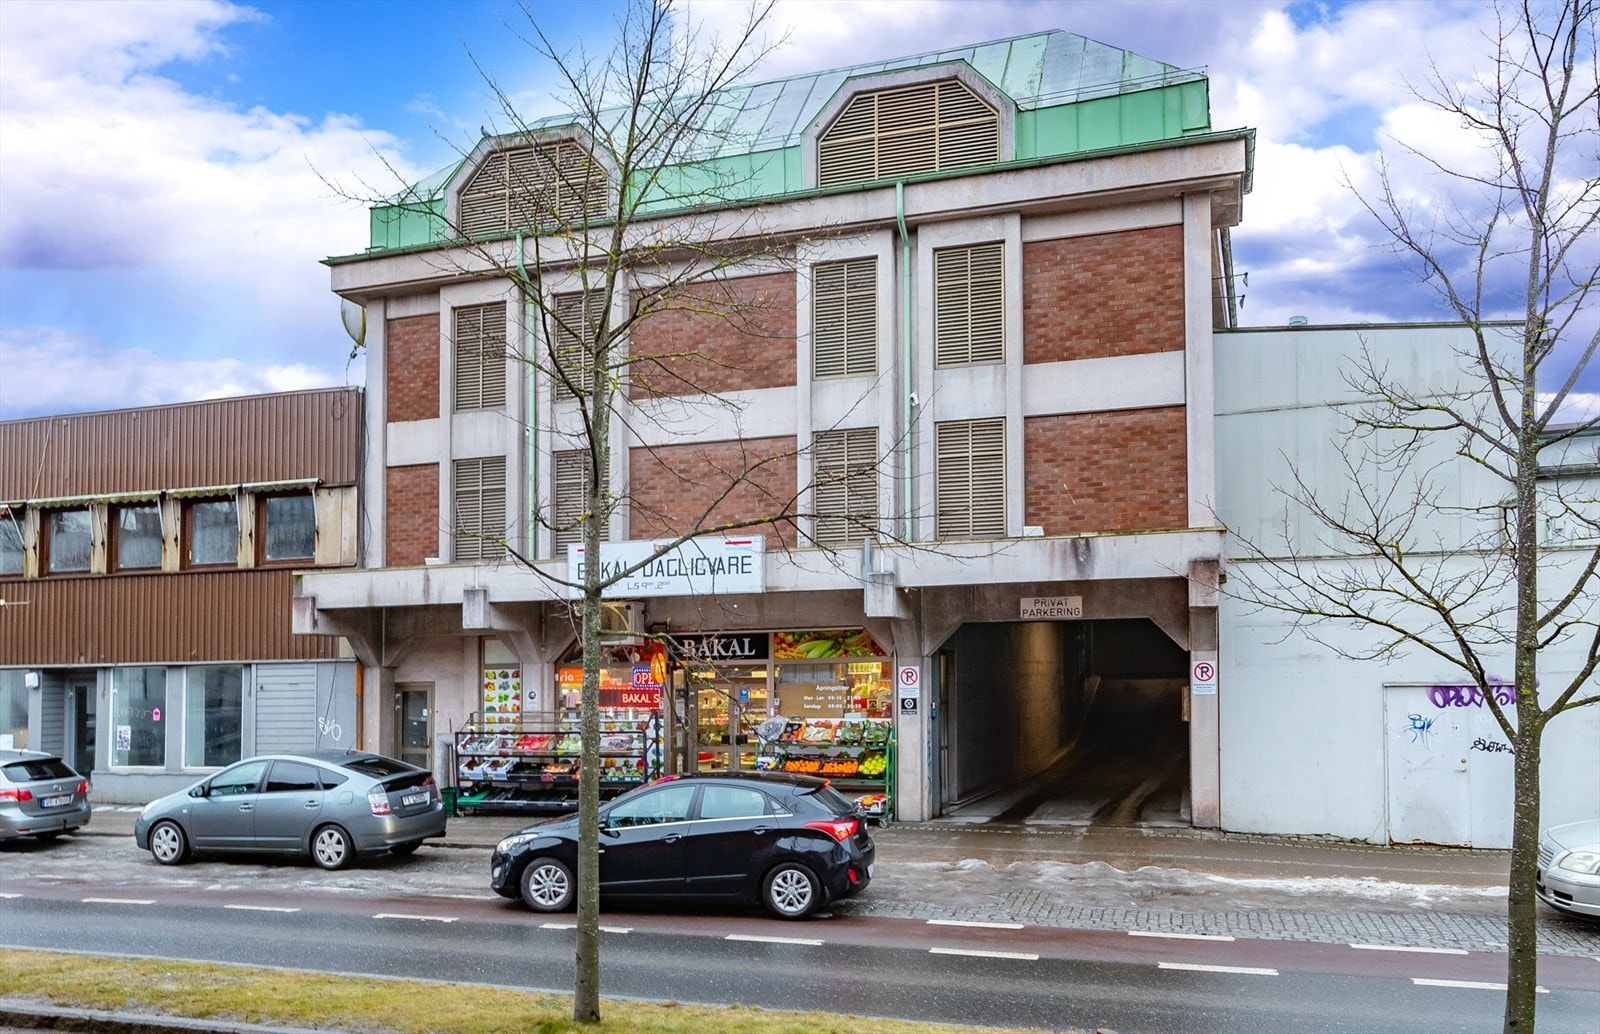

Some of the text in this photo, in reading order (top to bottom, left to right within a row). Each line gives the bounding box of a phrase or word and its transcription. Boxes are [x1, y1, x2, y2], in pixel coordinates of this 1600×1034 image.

[577, 560, 635, 580] BKAL
[1033, 598, 1069, 607] PRIVAT
[1022, 607, 1081, 617] PARKERING
[682, 637, 756, 657] BAKAL
[634, 673, 655, 685] OPE
[622, 693, 651, 703] BAKAL
